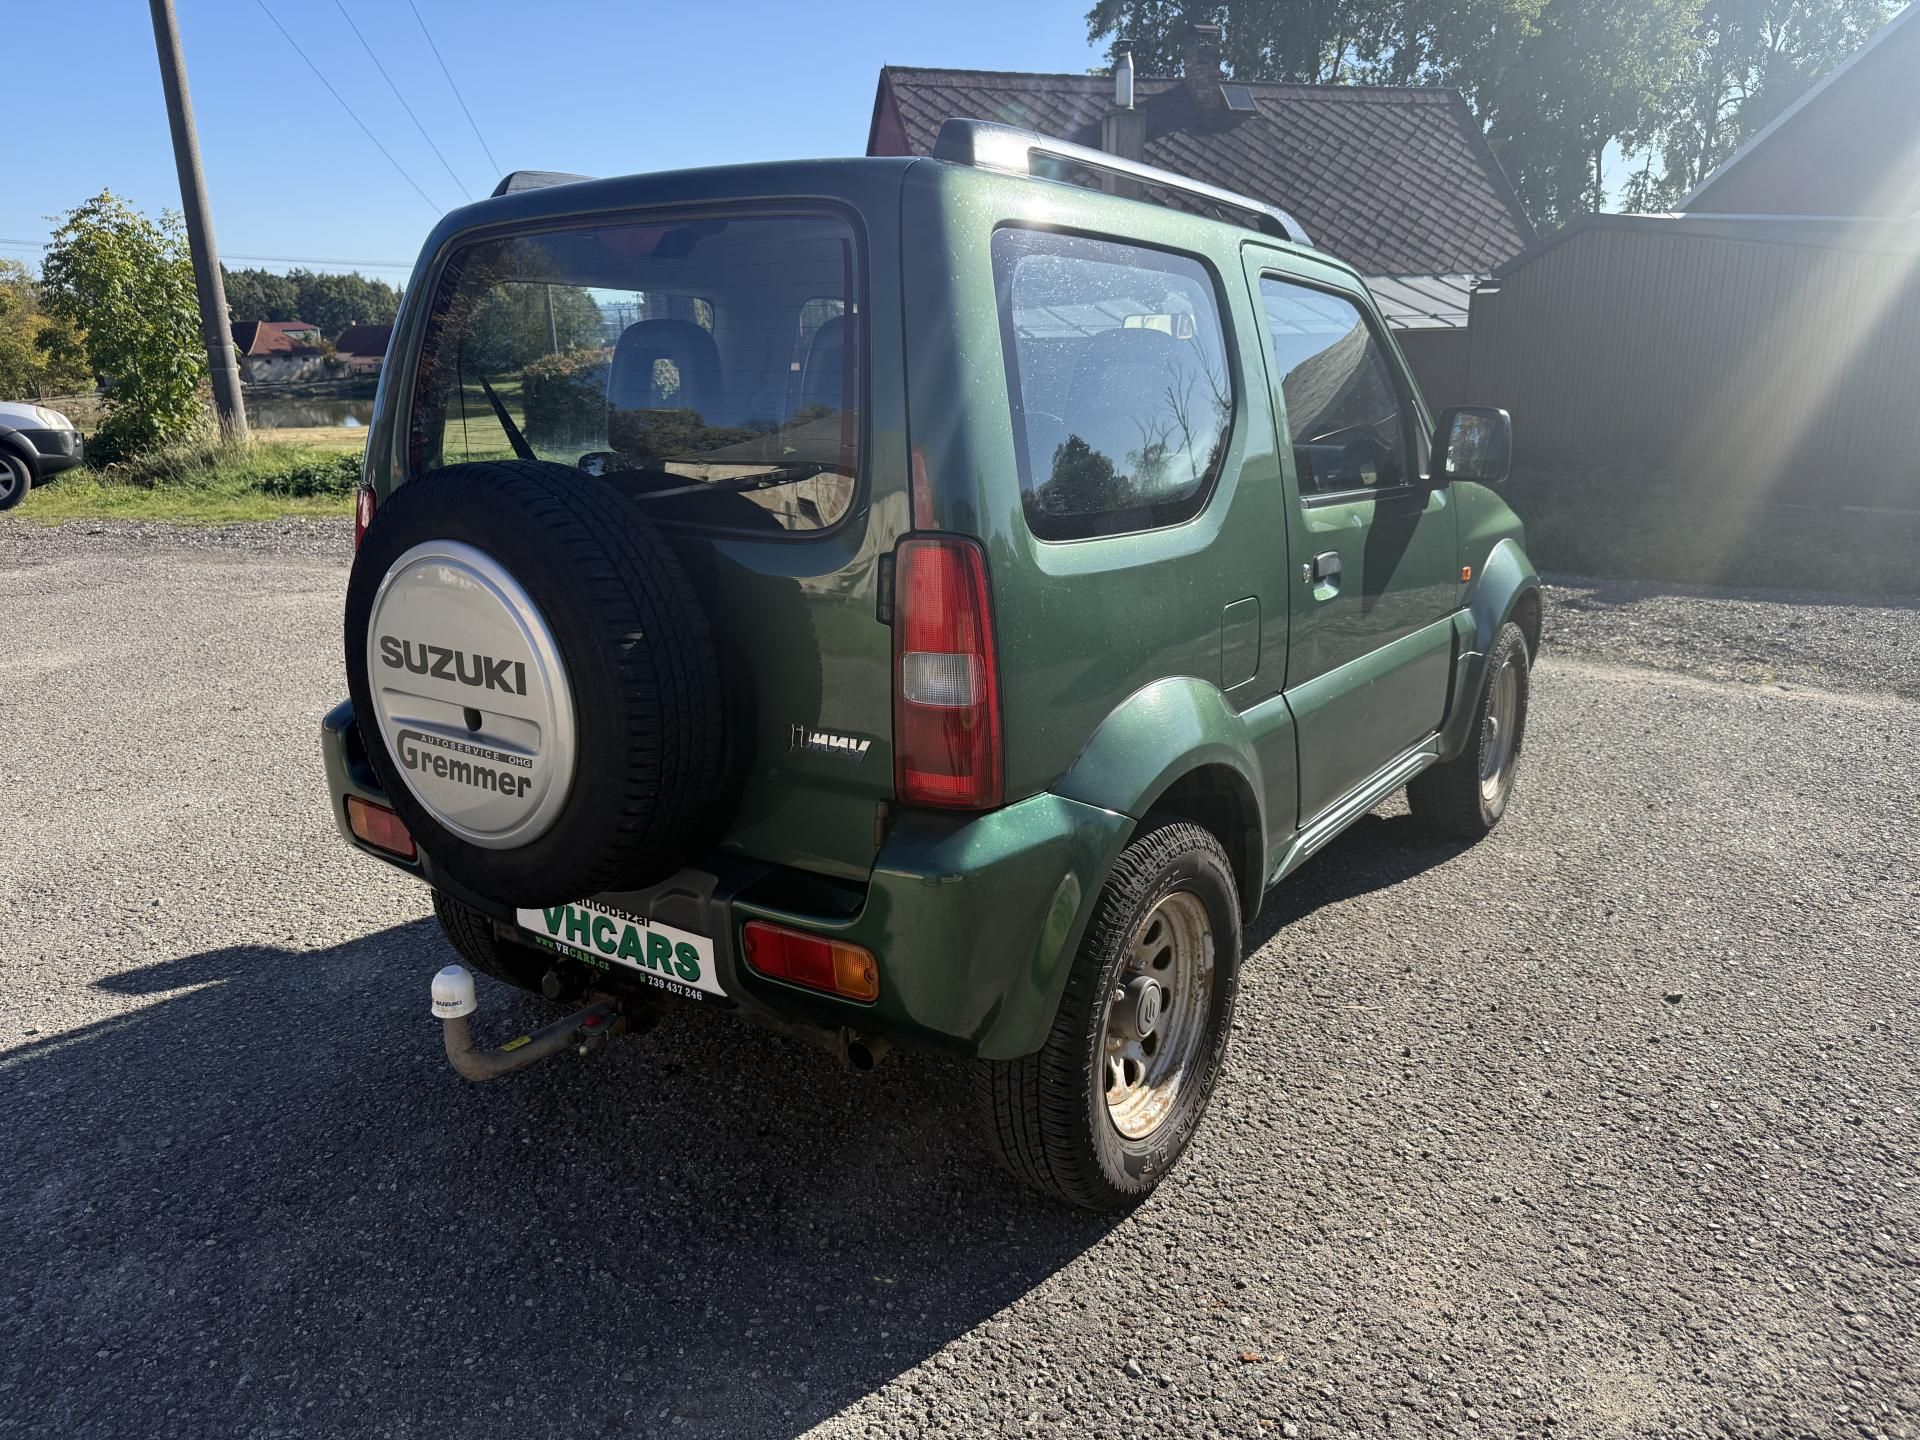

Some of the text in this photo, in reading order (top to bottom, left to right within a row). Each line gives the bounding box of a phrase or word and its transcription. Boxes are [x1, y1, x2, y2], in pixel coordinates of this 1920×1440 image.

[380, 635, 527, 696] SUZUKI
[397, 729, 532, 798] Gremmer
[421, 735, 531, 767] AUTOSERVICE OHG
[543, 904, 701, 983] VHCARS
[648, 975, 703, 1001] 739 437 246
